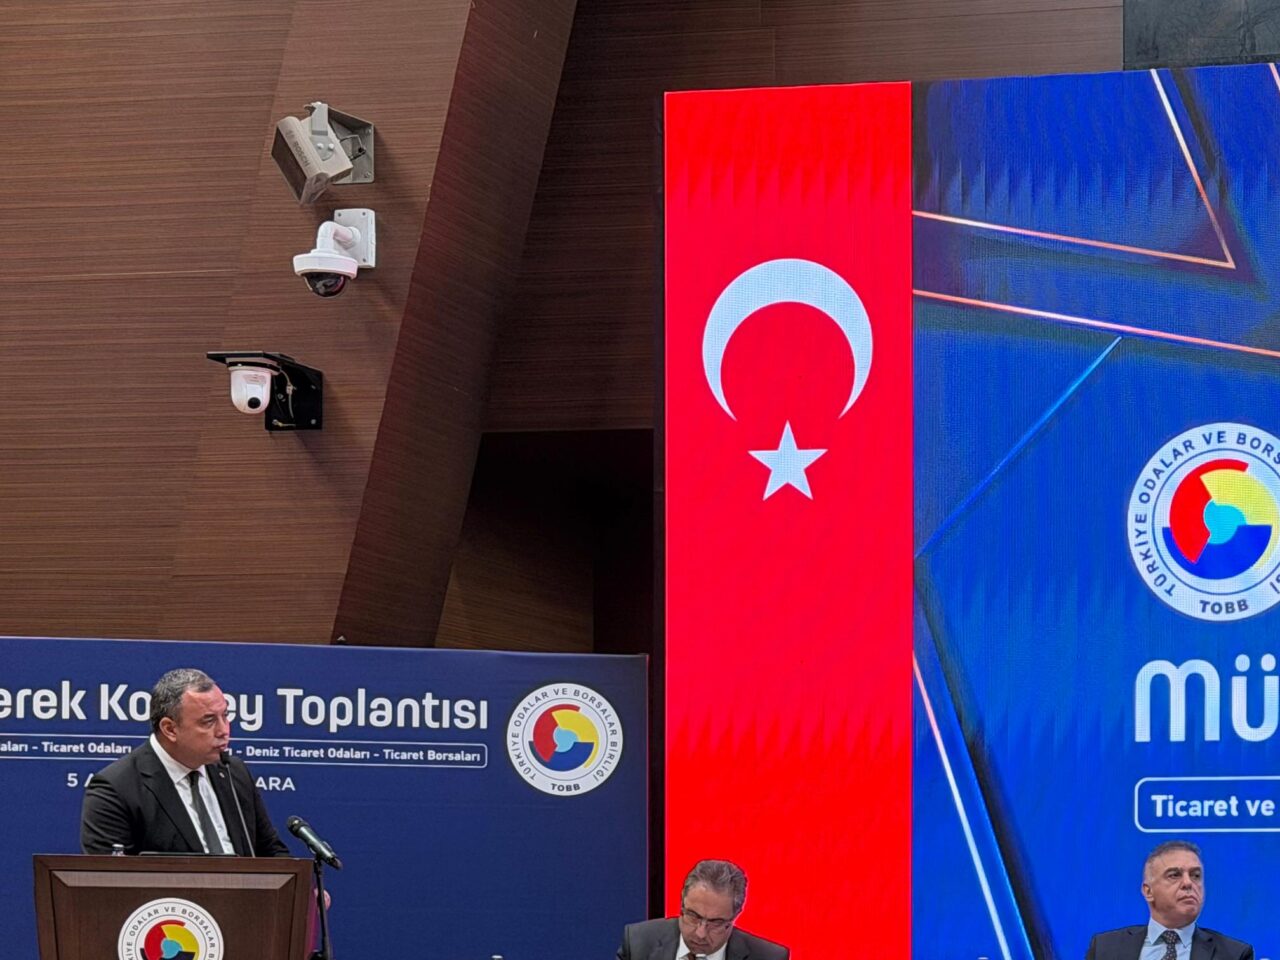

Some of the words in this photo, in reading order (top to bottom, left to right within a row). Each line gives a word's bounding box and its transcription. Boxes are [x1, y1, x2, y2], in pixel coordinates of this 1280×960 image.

[1138, 439, 1195, 504] ODALAR
[1202, 430, 1227, 444] VE
[1199, 599, 1249, 615] TOBB
[277, 688, 487, 732] Toplantısı
[514, 691, 549, 727] ODALAR
[573, 689, 617, 736] BORSALAR
[42, 742, 84, 752] Ticaret
[246, 746, 279, 756] Deniz
[283, 747, 324, 757] Ticaret
[328, 748, 369, 758] Odaları
[383, 749, 424, 759] Ticaret
[428, 750, 480, 761] Borsaları
[67, 773, 78, 787] 5
[551, 783, 581, 792] TOBB
[1151, 795, 1237, 817] Ticaret
[1246, 800, 1275, 816] ve
[129, 909, 159, 936] ODALAR
[181, 908, 215, 948] BORSALAR
